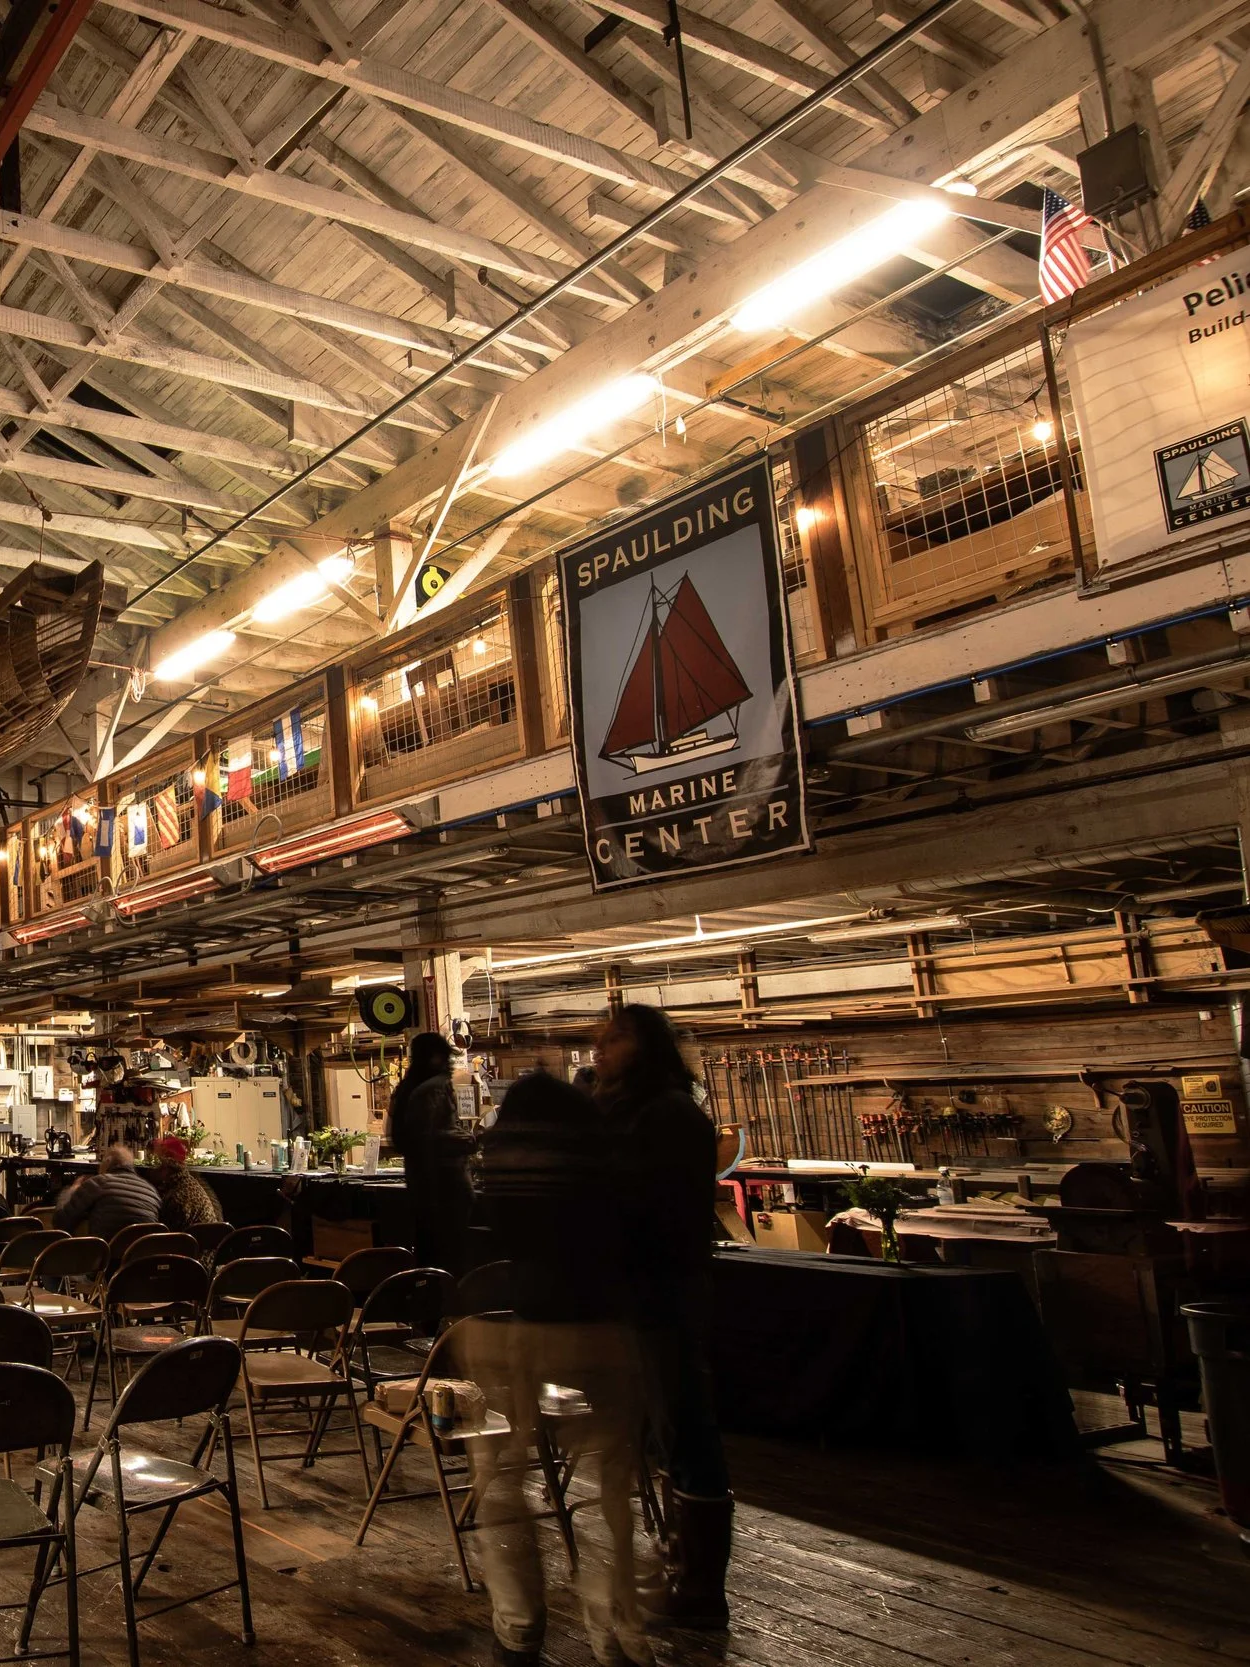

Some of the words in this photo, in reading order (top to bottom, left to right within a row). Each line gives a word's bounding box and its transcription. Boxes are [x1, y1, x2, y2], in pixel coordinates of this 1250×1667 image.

[1162, 426, 1241, 460] SPAULDING
[1189, 493, 1234, 510] MARINE
[577, 486, 755, 588] SPAULDING
[629, 769, 737, 816] MARINE
[596, 800, 789, 864] CENTER
[1183, 1103, 1229, 1113] CAUTION
